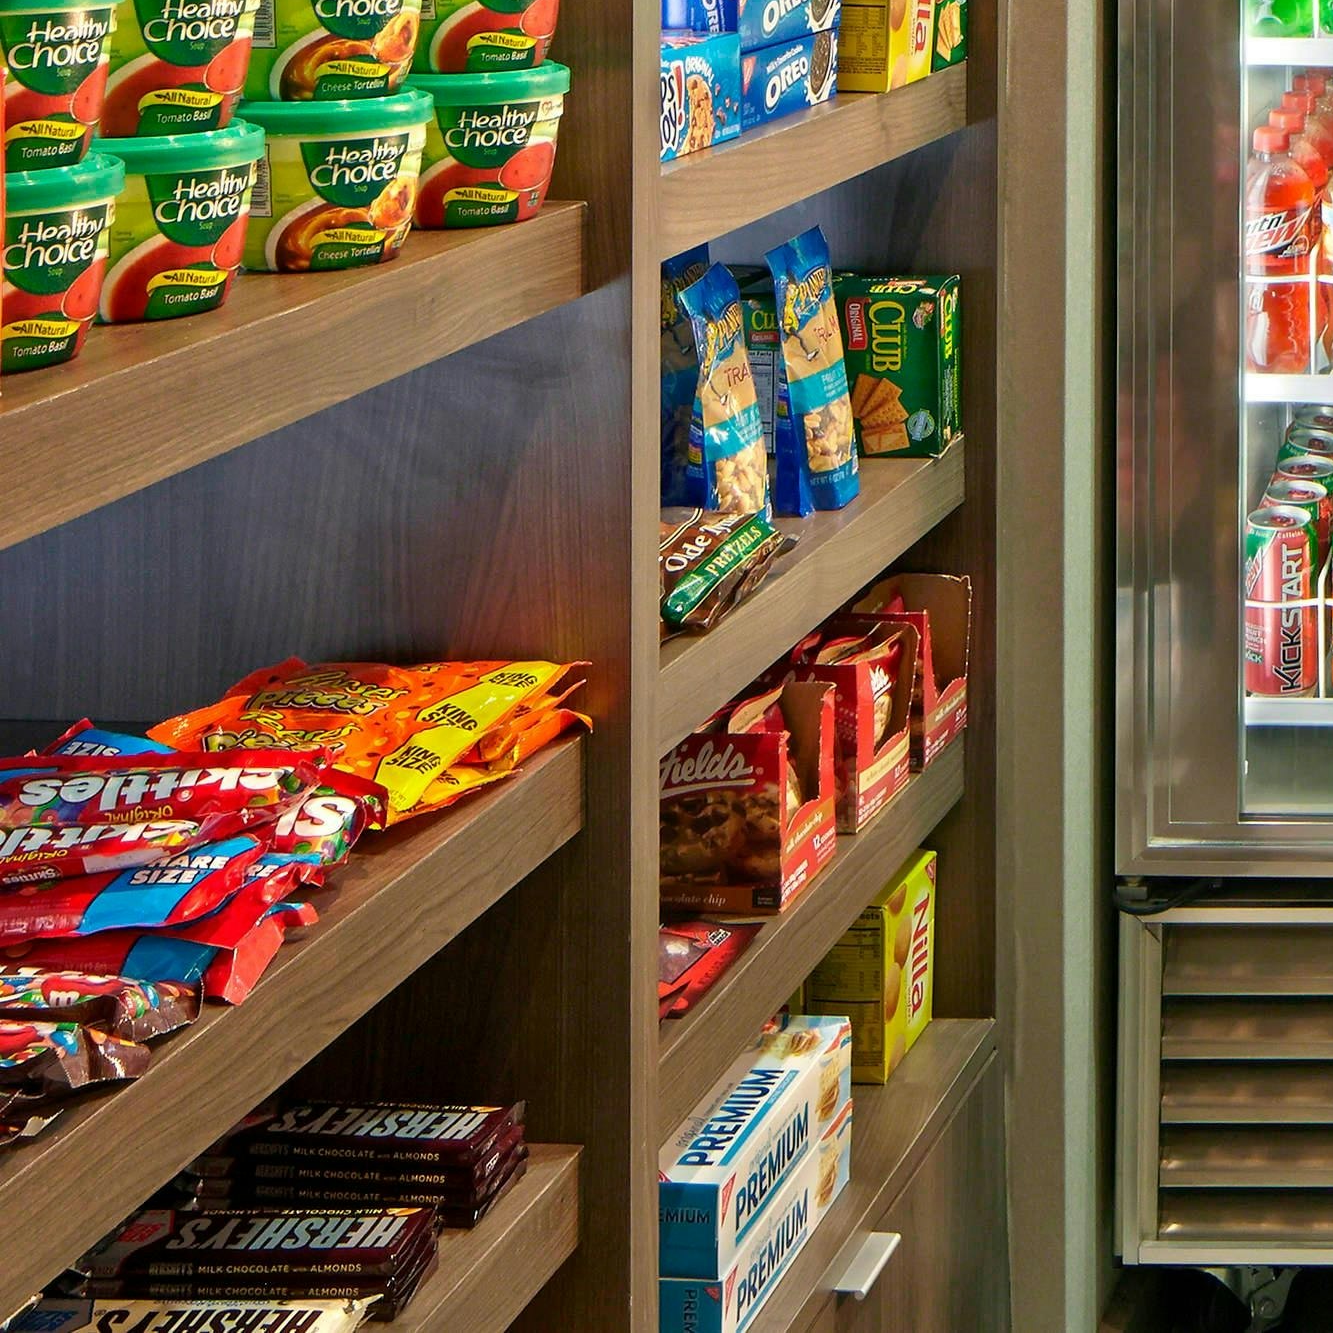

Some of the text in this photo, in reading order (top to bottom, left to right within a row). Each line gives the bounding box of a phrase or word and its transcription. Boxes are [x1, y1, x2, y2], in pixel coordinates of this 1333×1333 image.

[27, 18, 108, 43] Healthy
[143, 17, 235, 42] Choice
[487, 34, 528, 47] All Natural
[8, 40, 99, 70] Choice
[481, 50, 528, 61] Tomato Basil
[335, 63, 380, 75] All Natural
[685, 55, 713, 88] ORIGINAL
[321, 82, 351, 92] Cheese
[765, 56, 809, 110] OREO
[163, 92, 212, 105] All Natural
[157, 109, 213, 123] Tomato Basil
[458, 105, 535, 129] Healthy
[28, 124, 77, 136] All Natural
[445, 126, 527, 147] Choice
[21, 141, 76, 158] Tomato Basil
[326, 138, 405, 164] Healthy
[173, 169, 248, 199] Healthy
[311, 161, 396, 187] Choice
[461, 190, 508, 201] All Natural
[155, 195, 239, 223] Choice
[458, 204, 510, 216] Tomato Basil
[18, 211, 104, 243] Healthy
[332, 232, 376, 241] All Natural
[4, 237, 94, 269] Choice
[318, 250, 348, 260] Cheese
[171, 272, 218, 284] All Natural
[165, 287, 218, 304] Tomato Basil
[20, 323, 69, 335] All Natural
[849, 302, 865, 343] ORIGINAL
[13, 338, 69, 357] Tomato Basil
[868, 300, 906, 373] CLUB
[723, 362, 752, 387] TRA
[665, 534, 712, 573] Olde
[704, 525, 762, 578] PRETZELS
[1273, 544, 1302, 692] KICKSTART
[494, 670, 539, 688] KING
[436, 702, 479, 733] KING
[399, 744, 442, 769] KING
[19, 767, 296, 812] Skittles
[130, 869, 202, 886] SIZE
[910, 892, 932, 1019] Nilla
[268, 1108, 489, 1140] HERSHEY'S
[676, 1067, 786, 1167] PREMIUM
[293, 1148, 440, 1162] MILK CHOCOLATE ALMONDS
[735, 1100, 809, 1231] PREMIUM
[299, 1169, 446, 1184] MILK CHOCOLATE ALMONDS
[323, 1191, 380, 1202] CHOCOLATE
[165, 1216, 409, 1250] HERSHEY'S
[736, 1186, 809, 1324] PREMIUM
[198, 1264, 363, 1274] MILK CHOCOLATE ALMONDS
[197, 1286, 360, 1297] MILK CHOCOLATE ALMONDS
